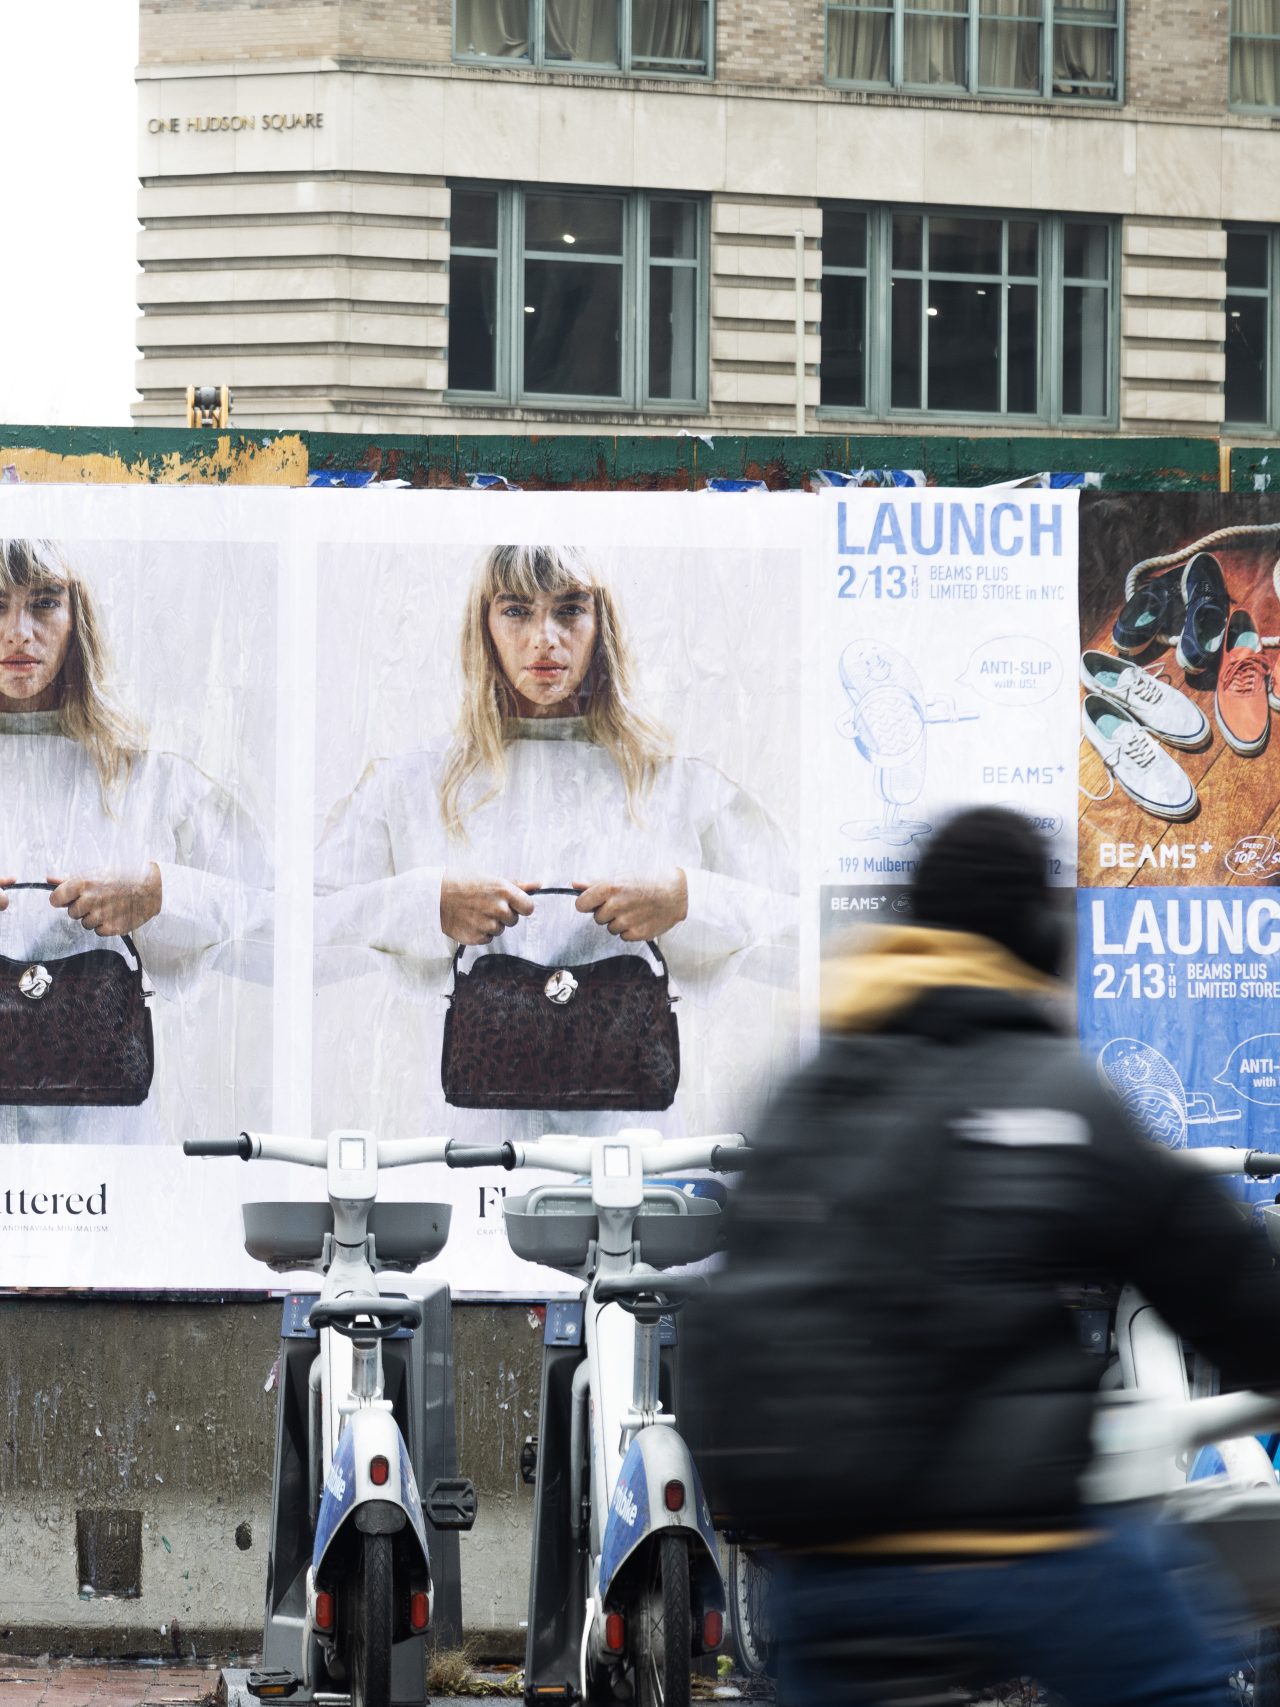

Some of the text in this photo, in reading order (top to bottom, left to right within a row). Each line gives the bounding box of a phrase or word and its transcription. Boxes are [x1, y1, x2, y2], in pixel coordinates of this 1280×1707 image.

[148, 113, 324, 134] ONE HUDSON SQUARE
[837, 501, 1063, 557] LAUNCH
[930, 565, 1009, 581] BEAMS PLUS
[837, 565, 908, 600] 2/13
[930, 584, 1065, 600] LIMITED STORE in NYC
[980, 660, 1053, 675] ANTI-SLIP
[993, 679, 1037, 689] with US!
[838, 857, 859, 873] 199
[863, 857, 920, 876] Mulberry
[1091, 898, 1280, 956] LAUNC
[1187, 963, 1267, 980] BEAMS PLUS
[1093, 963, 1167, 999] 2/13
[1187, 981, 1280, 999] LIMITED STORE
[1240, 1058, 1280, 1074] ANTI-
[1252, 1076, 1276, 1088] with
[57, 1224, 109, 1233] MINIMALISM
